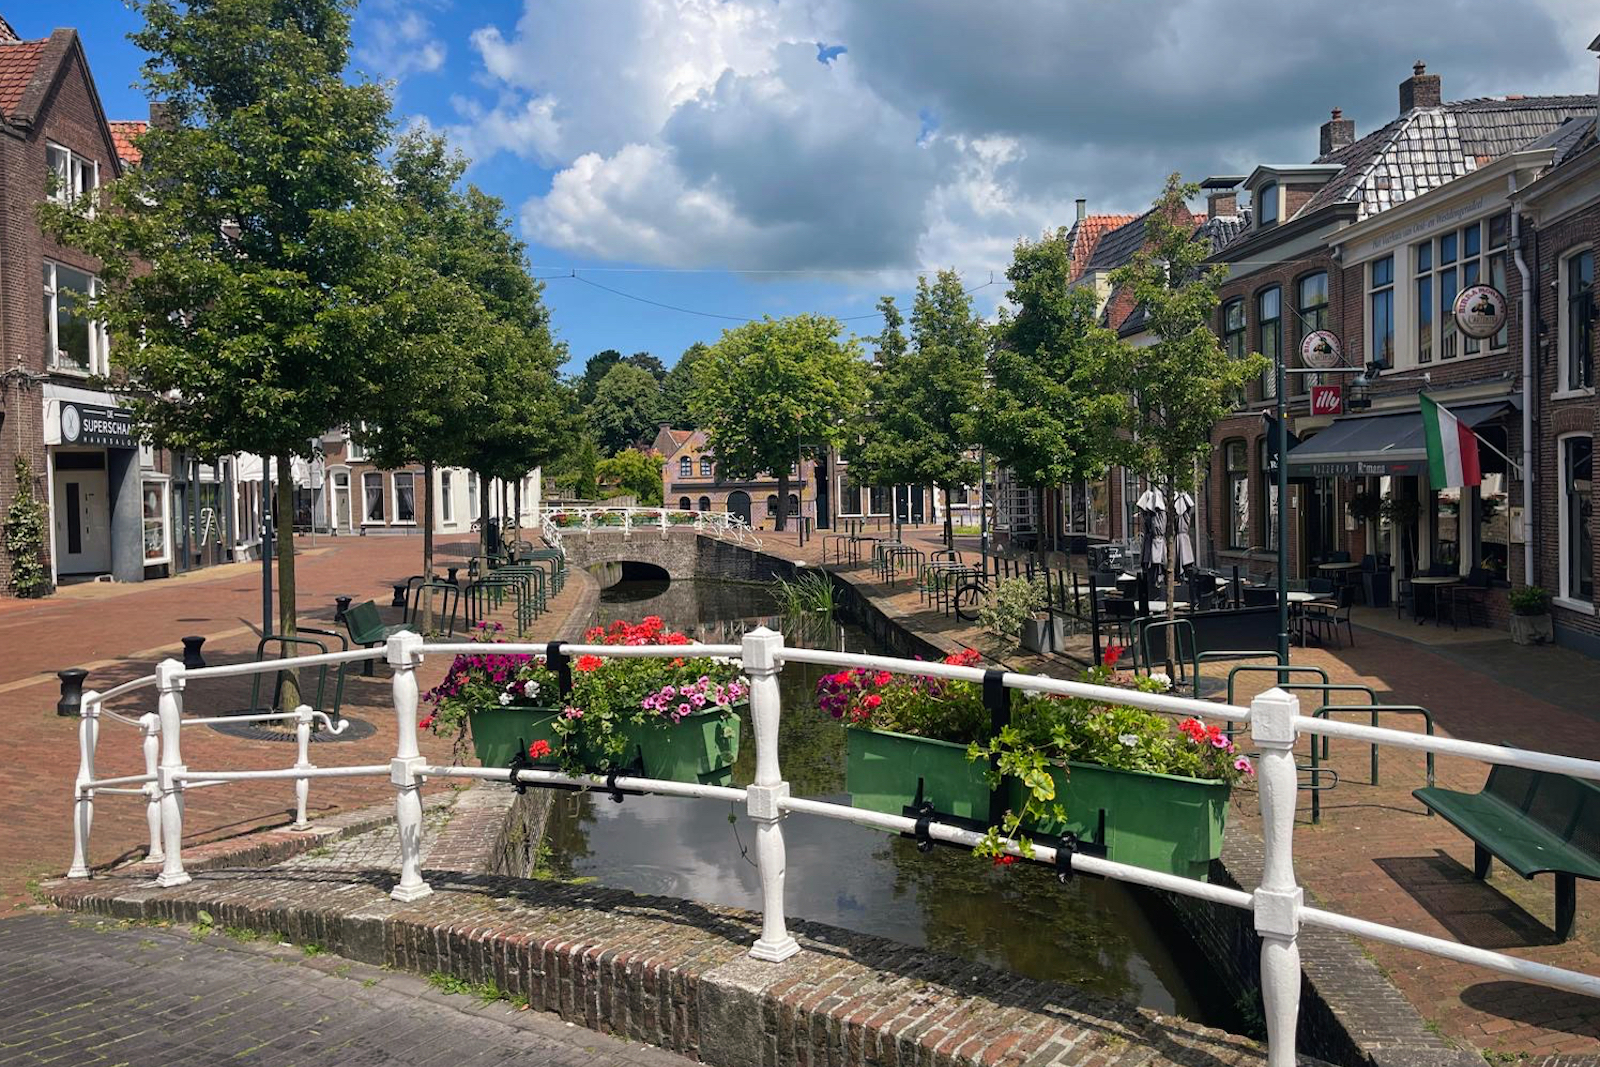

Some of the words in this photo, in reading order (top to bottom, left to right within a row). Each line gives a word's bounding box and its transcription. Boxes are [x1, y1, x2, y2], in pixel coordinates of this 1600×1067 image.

[1459, 290, 1479, 314] BIRRA
[1316, 390, 1340, 412] illy
[106, 410, 114, 419] DE
